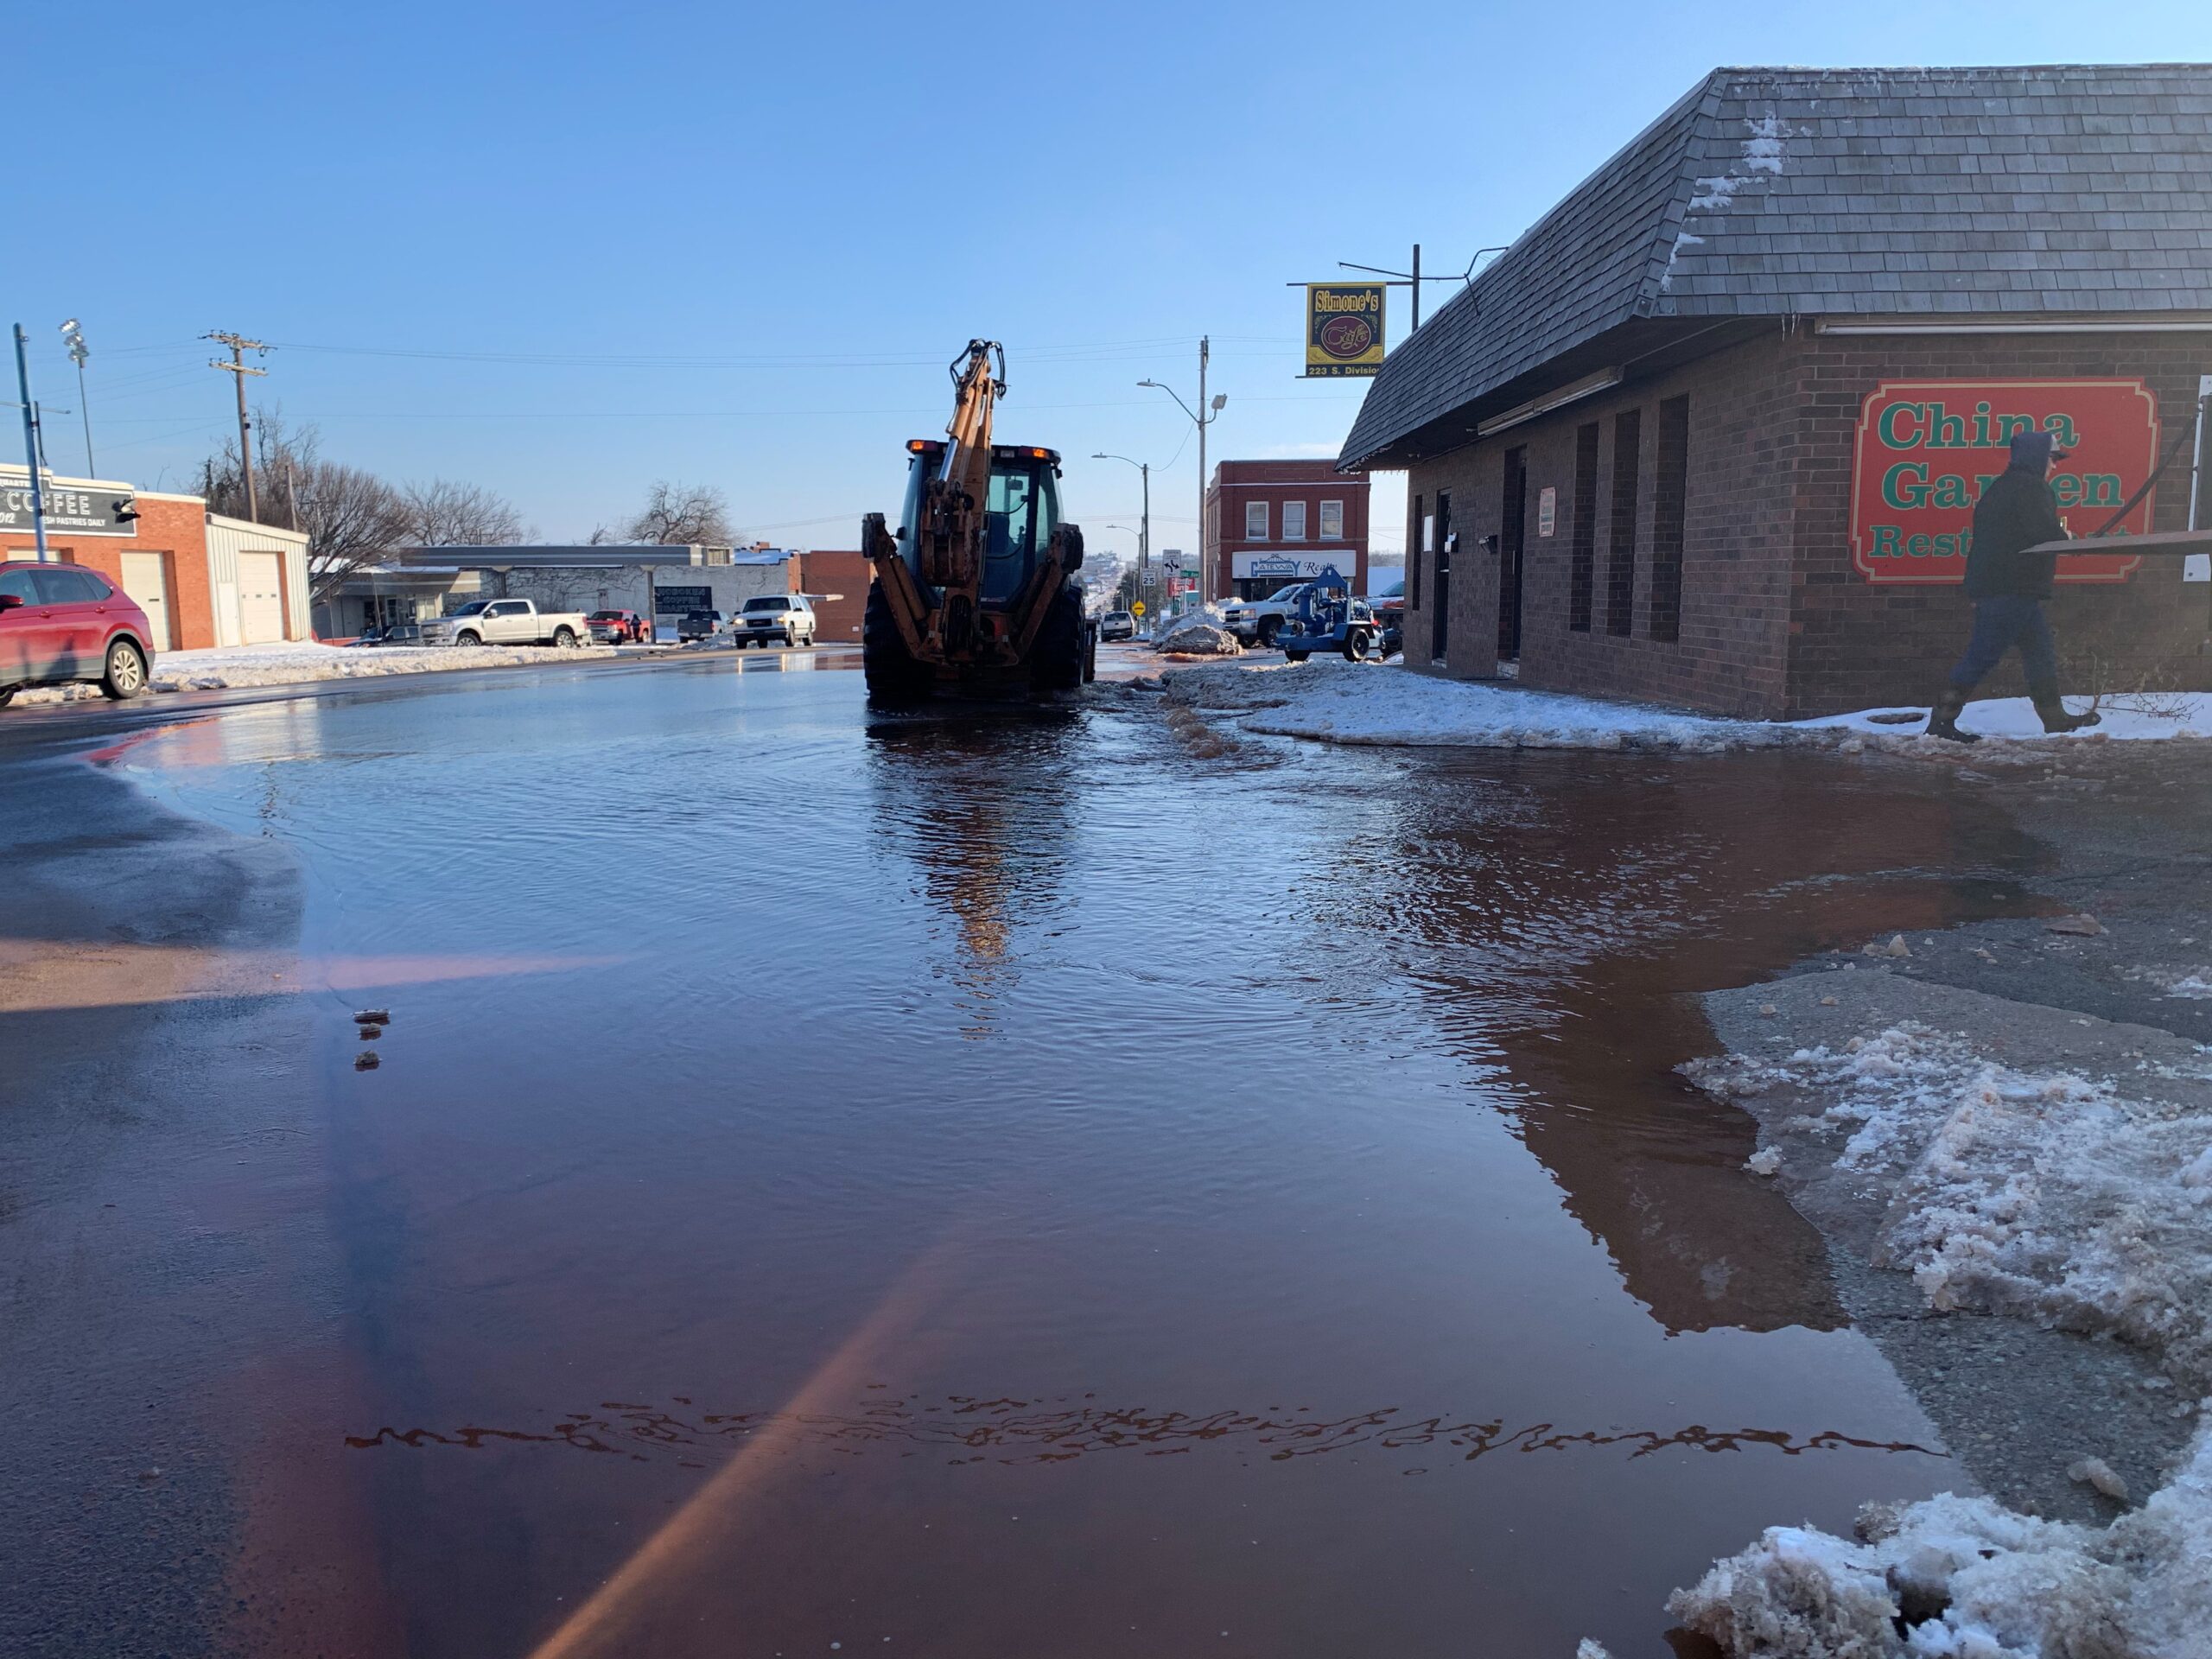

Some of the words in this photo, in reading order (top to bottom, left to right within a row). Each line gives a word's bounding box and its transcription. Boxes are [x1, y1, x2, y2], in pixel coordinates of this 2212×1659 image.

[1315, 289, 1379, 312] Simone's
[1878, 401, 2081, 451] China
[1882, 462, 2126, 511] Garen
[56, 517, 86, 525] PASTRIES
[1251, 561, 1301, 577] GATEWAY
